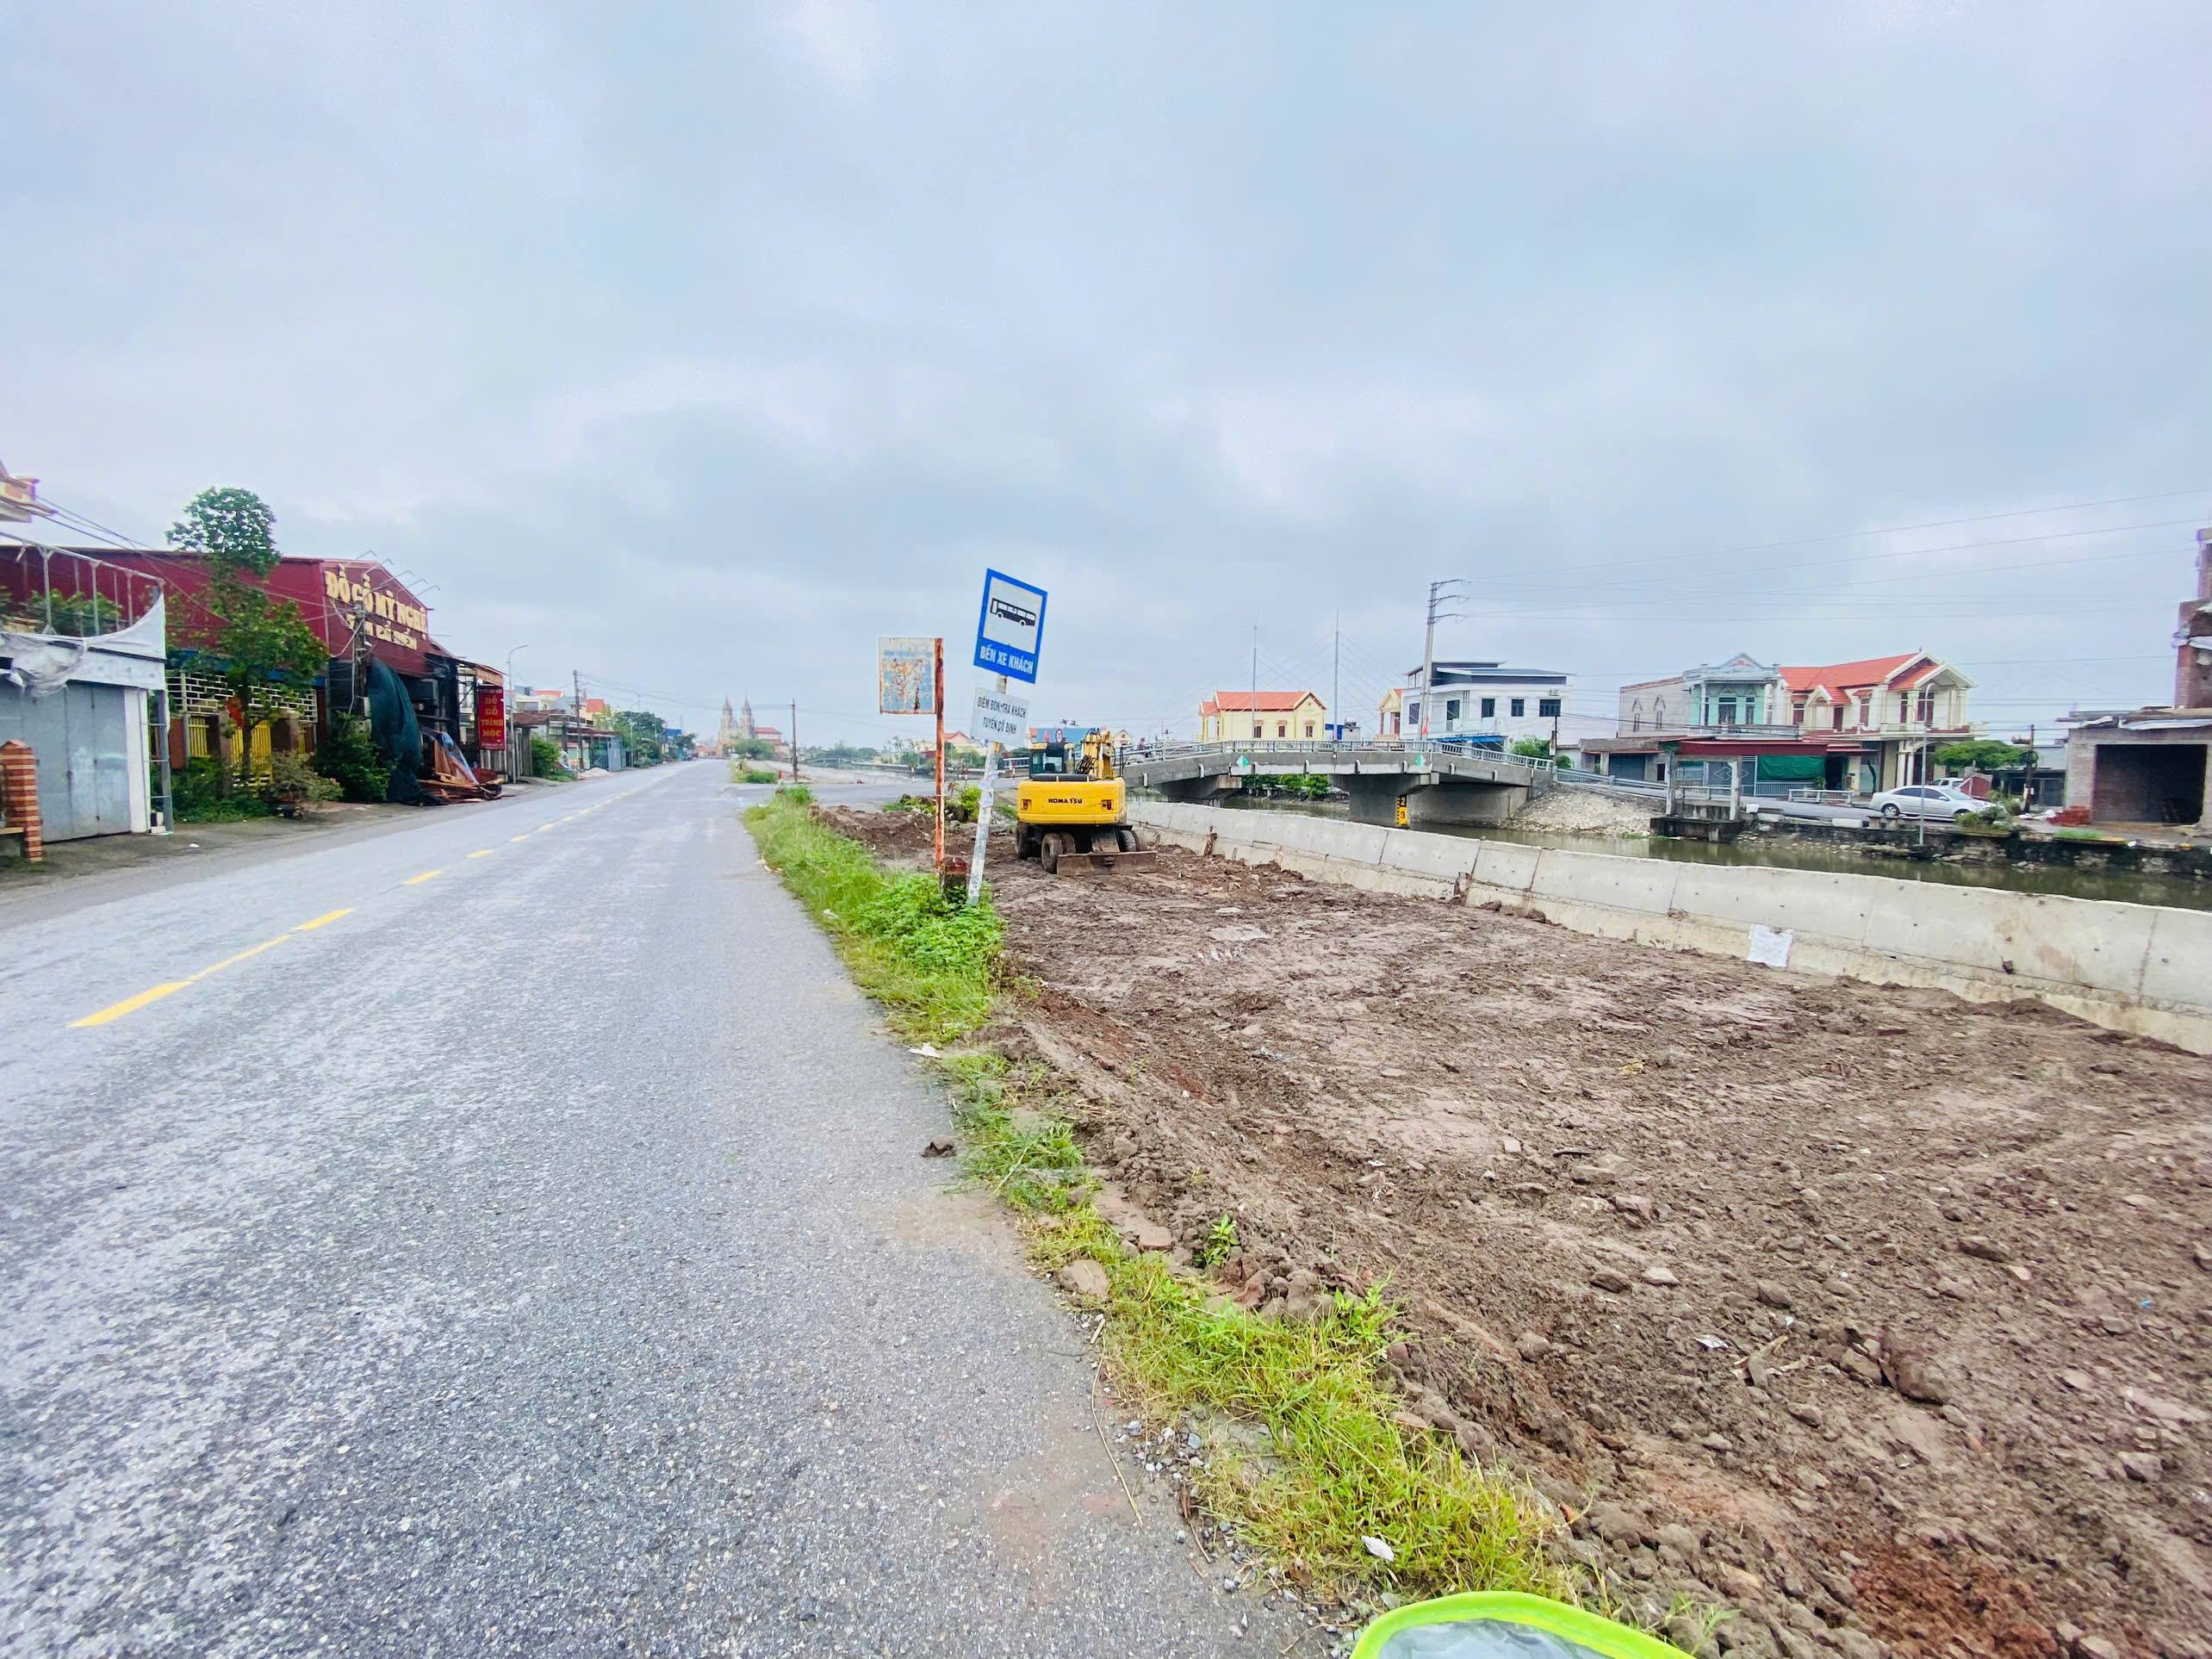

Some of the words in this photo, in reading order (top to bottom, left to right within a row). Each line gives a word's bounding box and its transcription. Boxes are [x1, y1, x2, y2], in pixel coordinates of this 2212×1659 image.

[979, 644, 997, 662] BẾN
[997, 650, 1008, 666] XE
[1008, 655, 1034, 674] KHÁCH
[1400, 797, 1405, 806] 2
